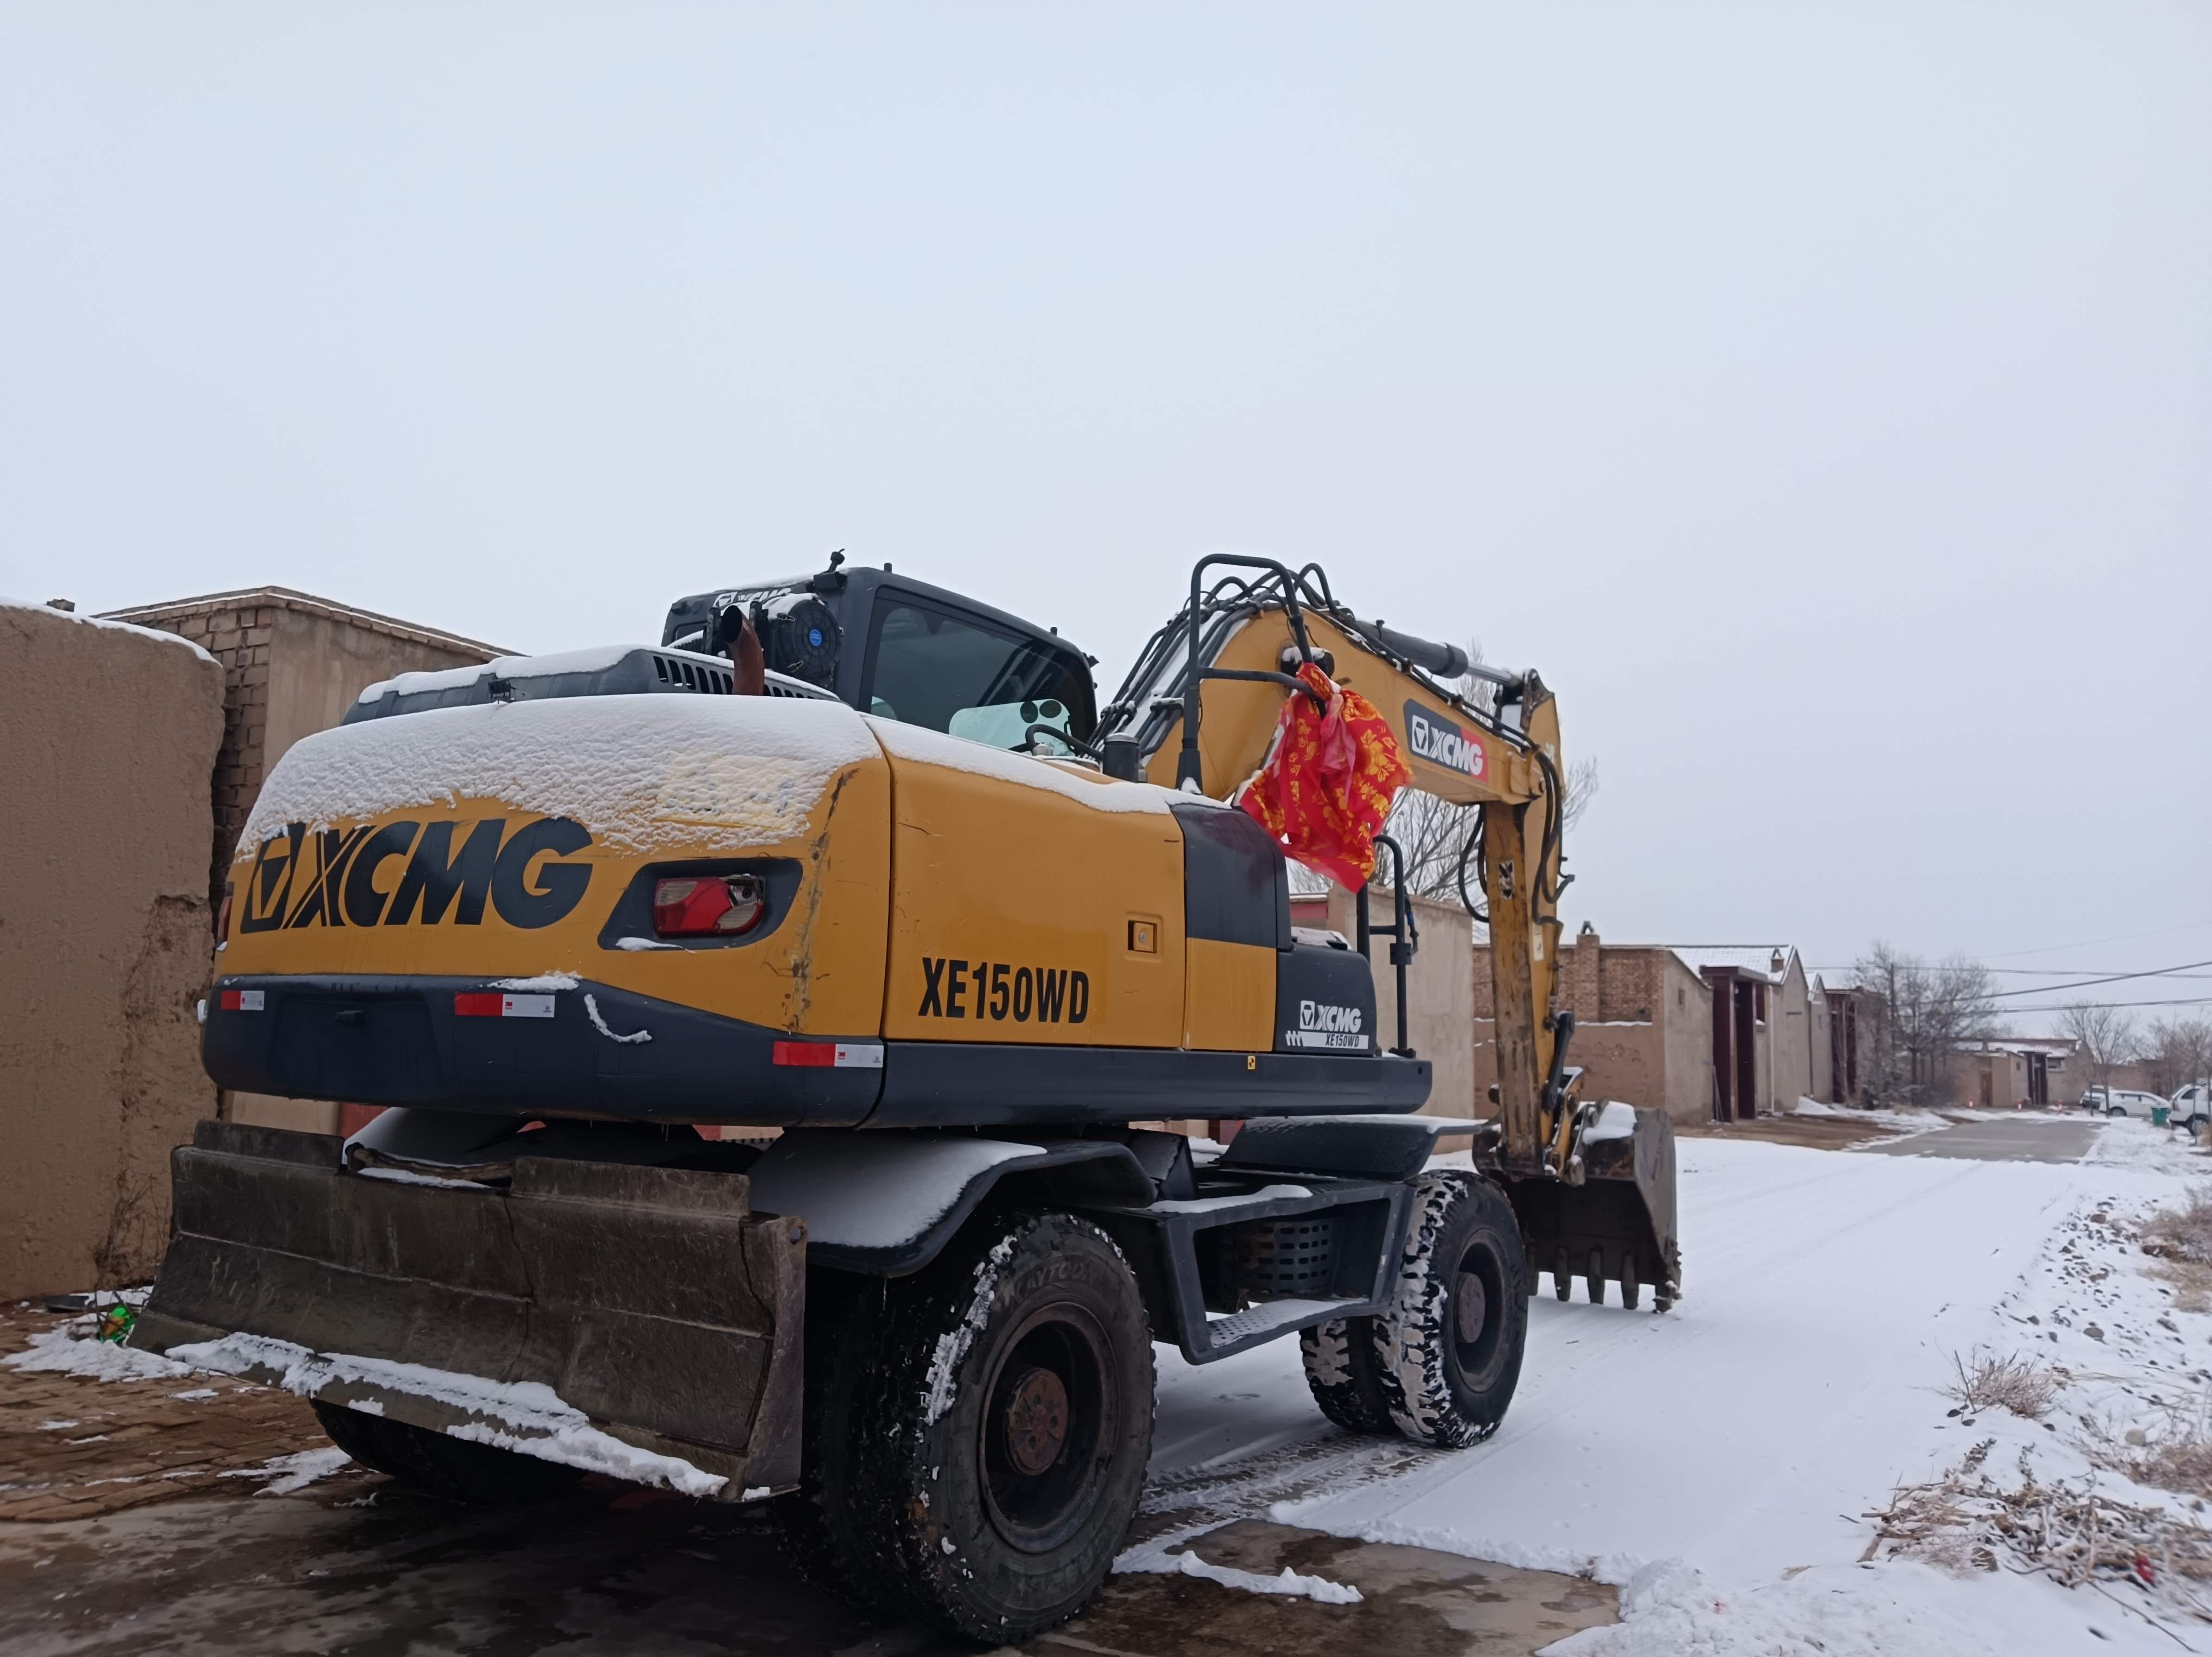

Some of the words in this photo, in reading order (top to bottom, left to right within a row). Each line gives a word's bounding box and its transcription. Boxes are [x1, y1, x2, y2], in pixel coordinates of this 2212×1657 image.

[1427, 727, 1483, 775] XCMG
[283, 817, 594, 929] XCMG
[918, 957, 1089, 1024] XE150WD
[1313, 1005, 1362, 1033] XCMG
[1325, 1033, 1360, 1047] XE150WD
